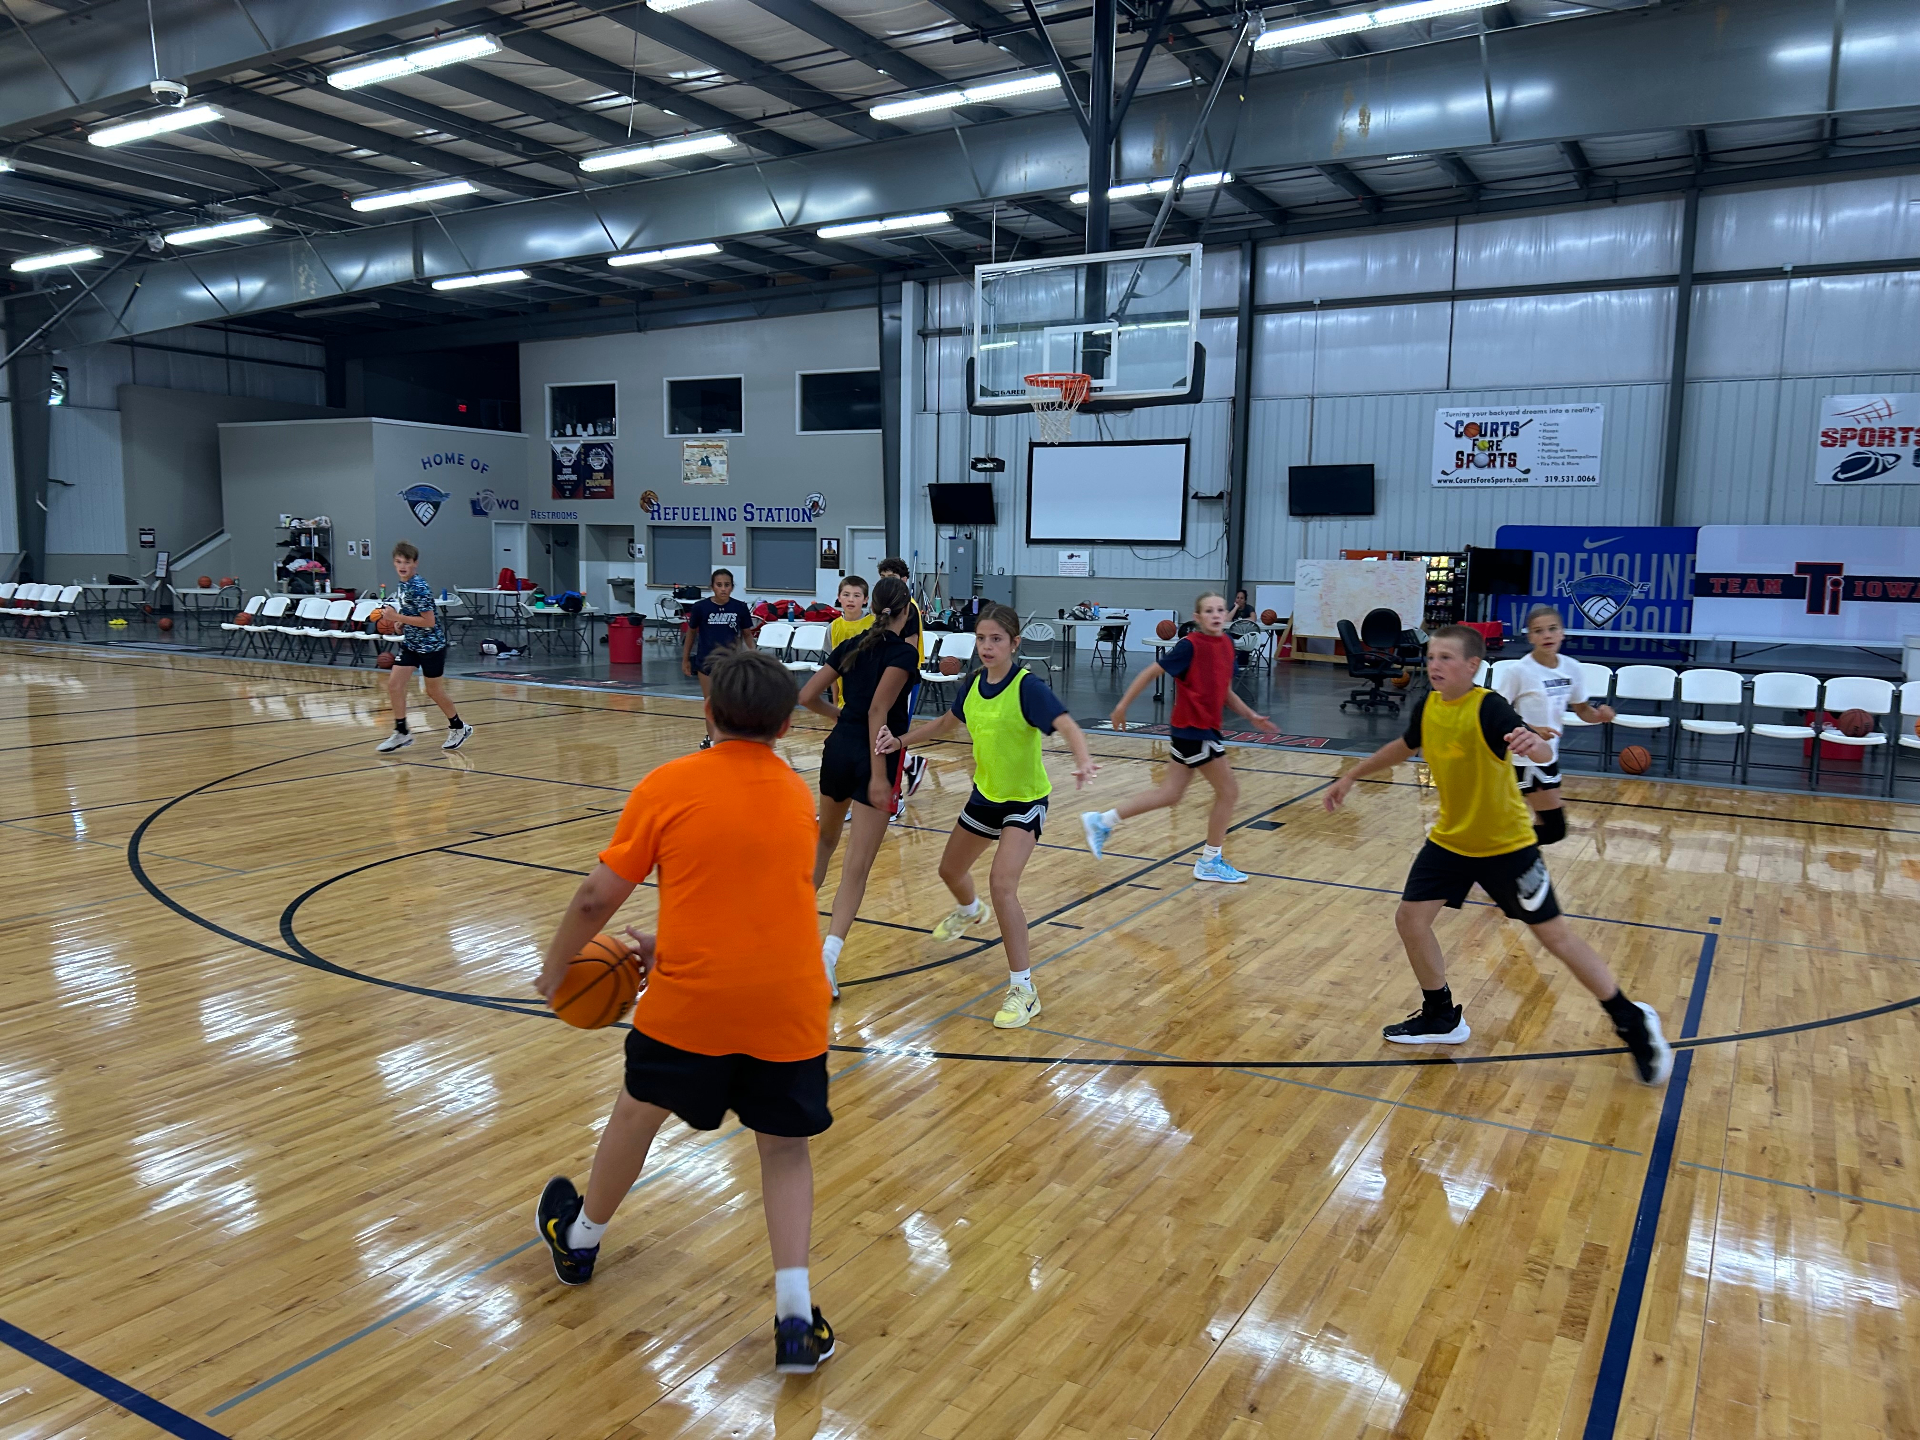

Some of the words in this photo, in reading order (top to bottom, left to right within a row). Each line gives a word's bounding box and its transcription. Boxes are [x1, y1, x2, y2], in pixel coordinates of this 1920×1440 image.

[421, 452, 465, 470] HOME
[470, 458, 490, 474] OF
[1437, 477, 1529, 485] www.CourtsForeSports.com
[1544, 475, 1596, 483] 319.531.0066
[1709, 577, 1783, 595] TEAM
[707, 612, 738, 622] SAINTS
